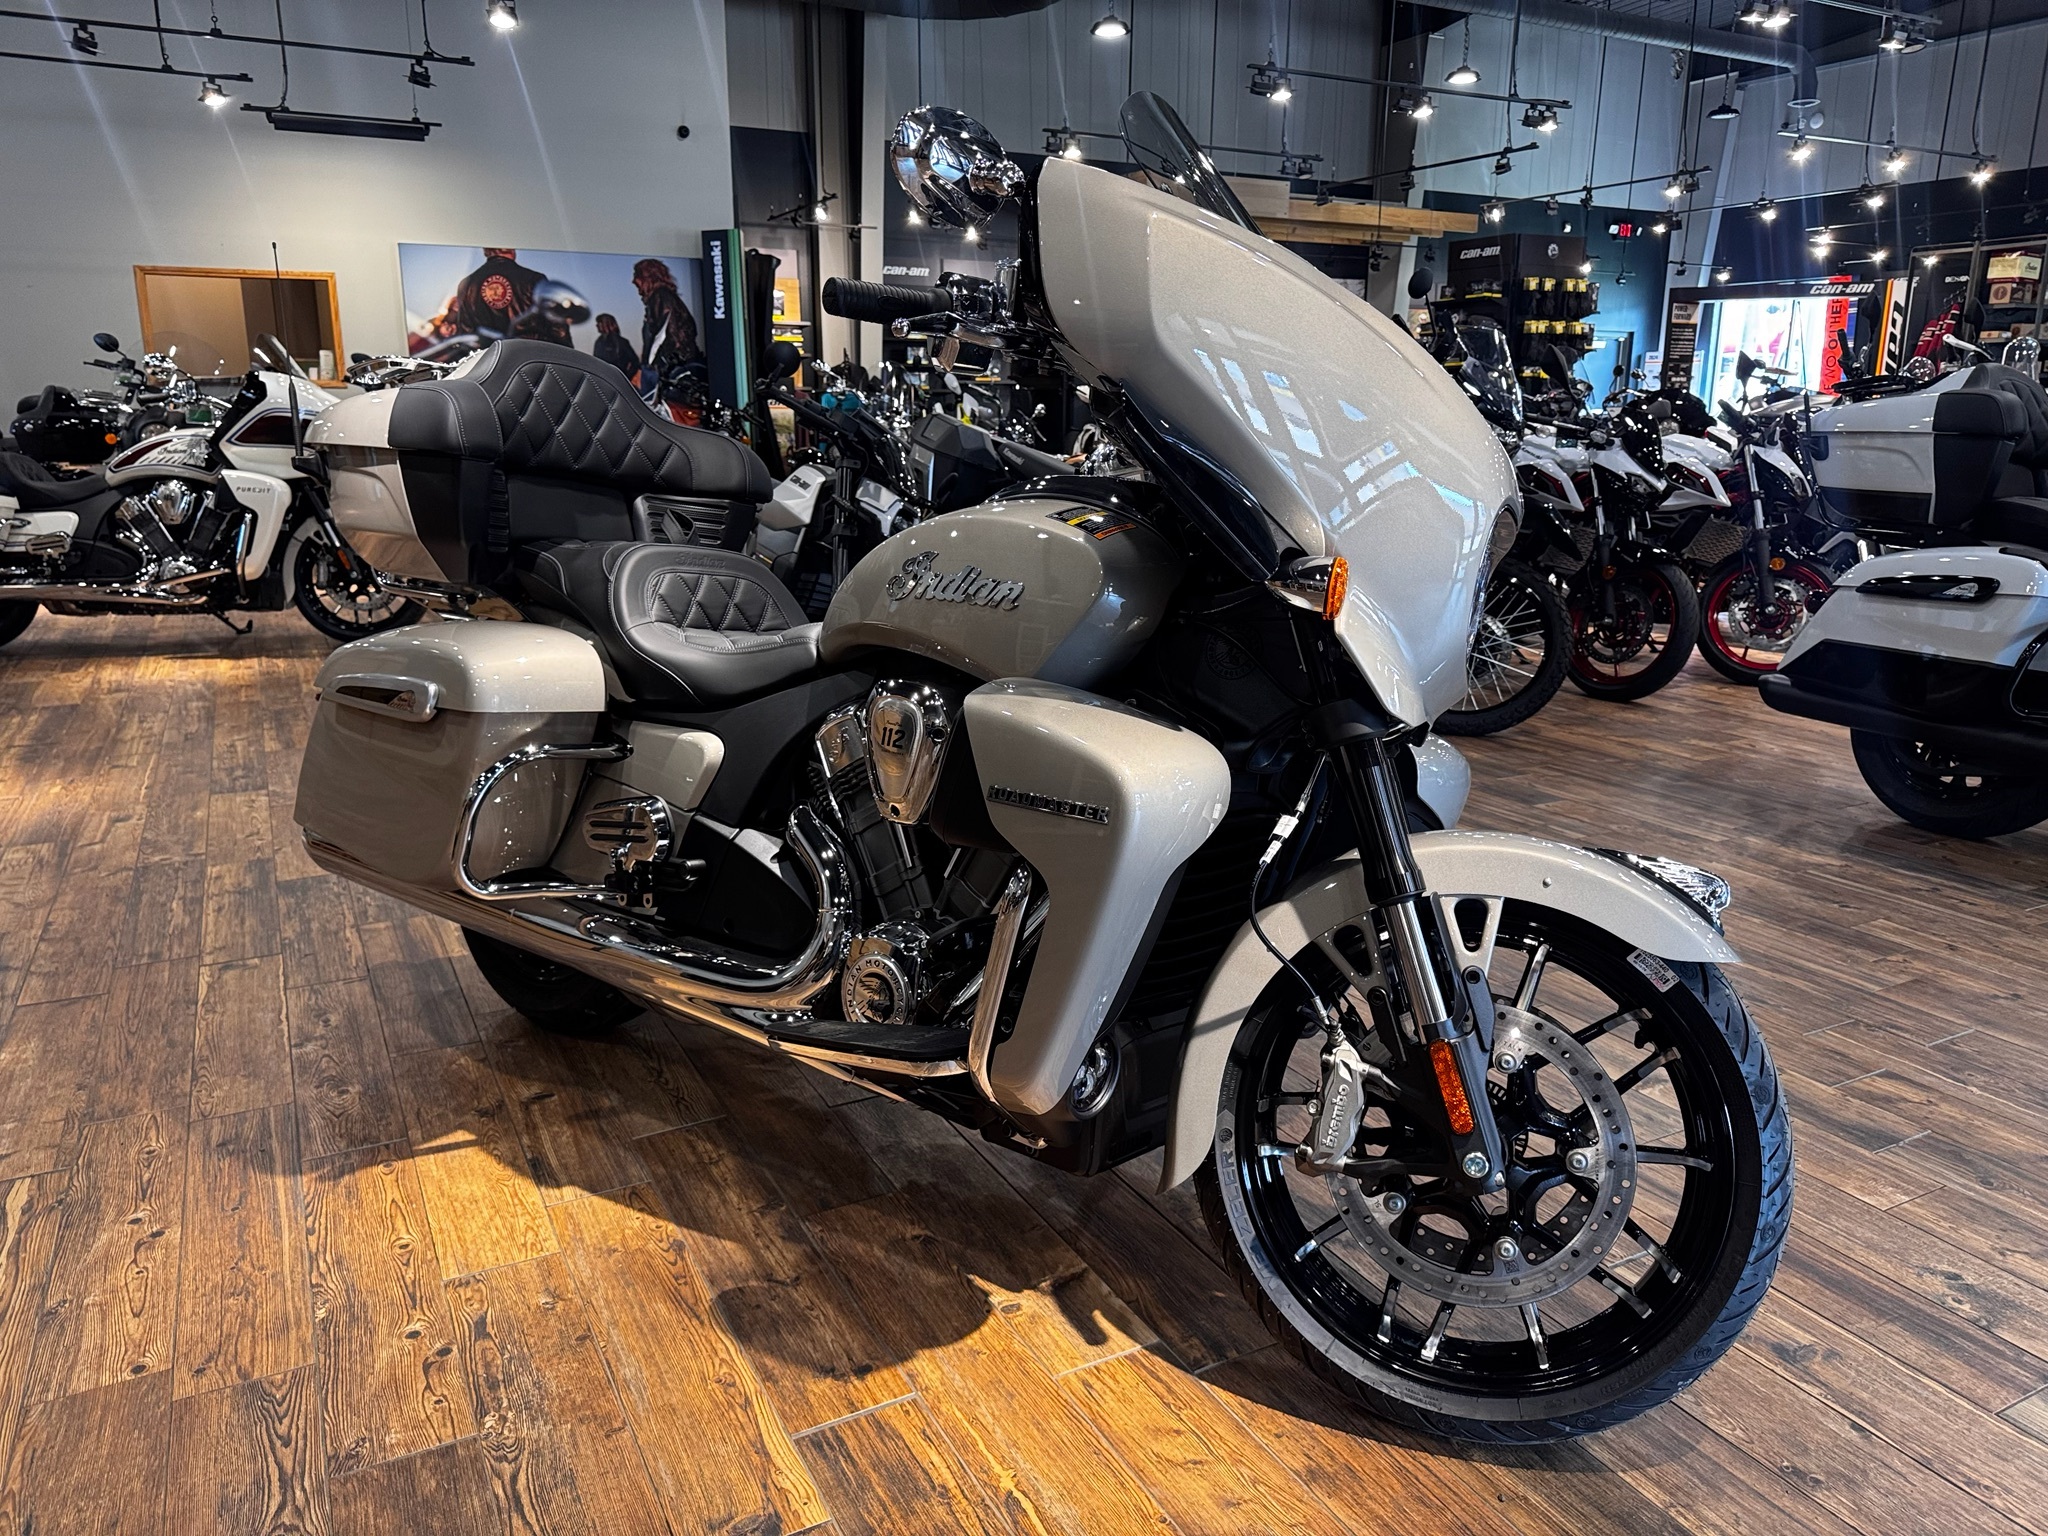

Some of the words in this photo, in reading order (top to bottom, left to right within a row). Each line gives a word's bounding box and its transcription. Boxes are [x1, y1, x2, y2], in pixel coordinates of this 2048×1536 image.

[1459, 245, 1501, 260] can-am
[710, 240, 726, 319] Kawasaki
[882, 265, 931, 277] can-am
[1809, 283, 1876, 295] can-am
[885, 550, 1025, 612] Indian
[881, 726, 906, 749] 112
[847, 965, 862, 1014] INDIAN
[1321, 1083, 1350, 1149] brembo
